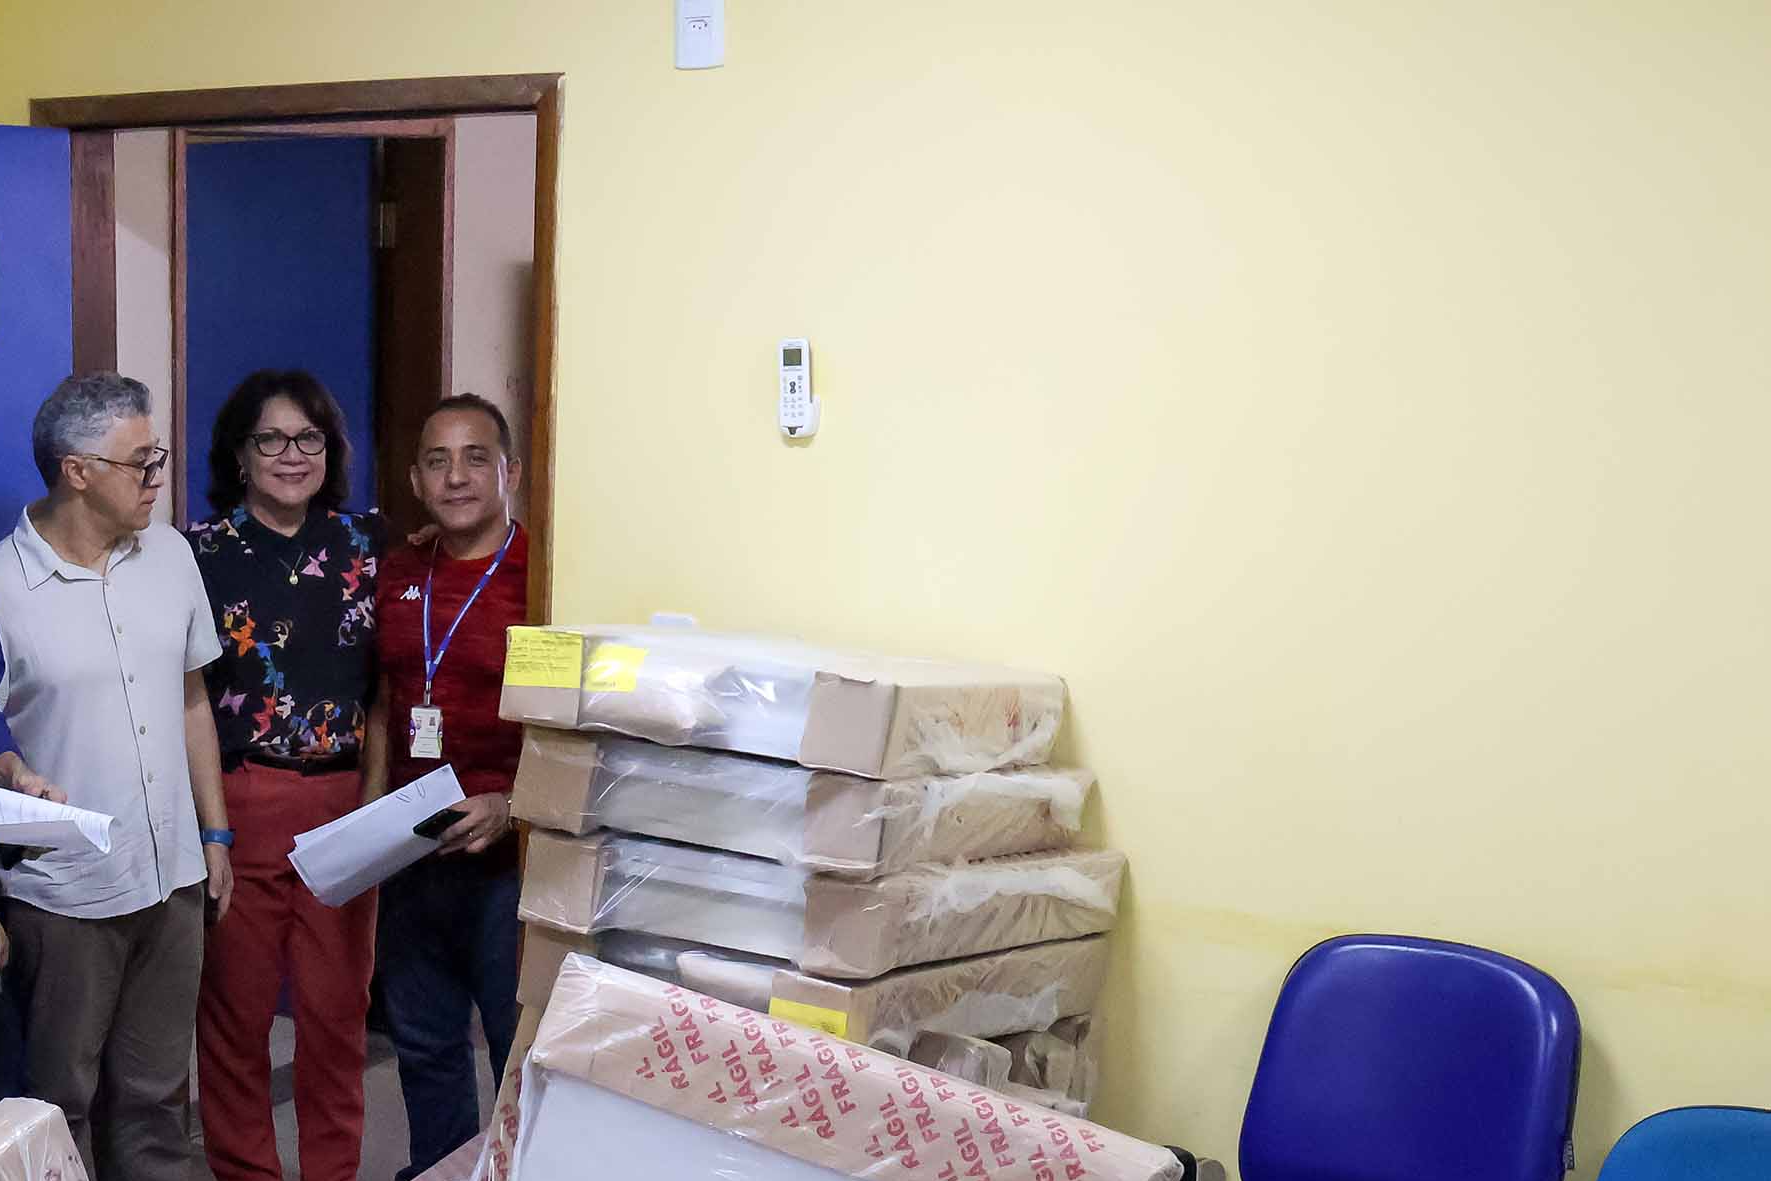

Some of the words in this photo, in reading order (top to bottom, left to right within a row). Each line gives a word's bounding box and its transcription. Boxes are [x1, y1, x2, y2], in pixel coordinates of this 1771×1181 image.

[650, 1016, 689, 1089] RÁGIL
[663, 984, 709, 1064] FRÁGI
[722, 1040, 758, 1111] RÁGIL
[794, 1064, 836, 1139] RÁGIL
[809, 1035, 857, 1115] FRÁGI
[895, 1066, 941, 1144] FRÁGI
[879, 1093, 920, 1169] RÁGIL
[968, 1091, 1016, 1168] FRÁGI
